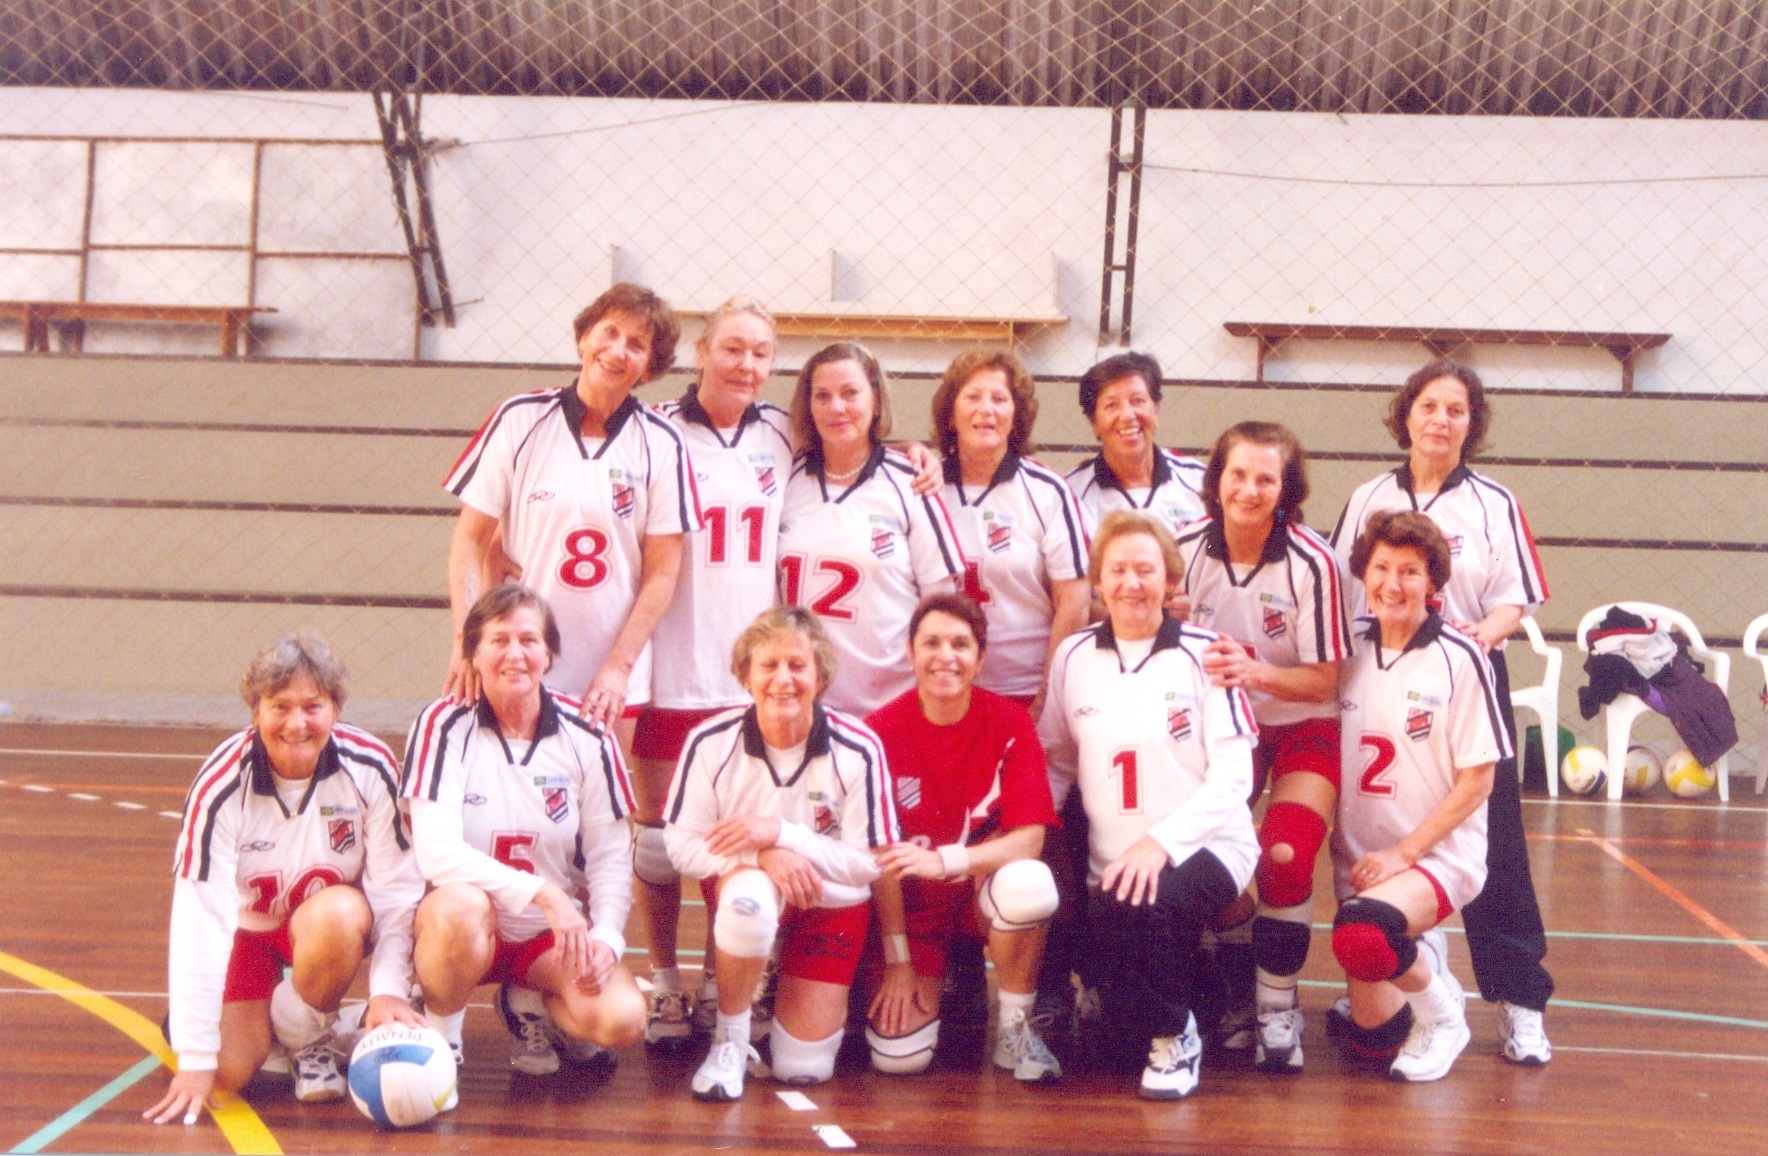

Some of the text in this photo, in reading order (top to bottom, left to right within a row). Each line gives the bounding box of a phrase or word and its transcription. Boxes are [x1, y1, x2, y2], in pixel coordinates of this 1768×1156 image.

[558, 527, 611, 590] 8
[702, 505, 765, 565] 11
[779, 555, 859, 620] 12
[1111, 747, 1142, 812] 1
[1359, 733, 1399, 797] 2
[490, 831, 535, 875] 5
[248, 866, 344, 914] 10
[361, 1030, 422, 1050] PENALTY
